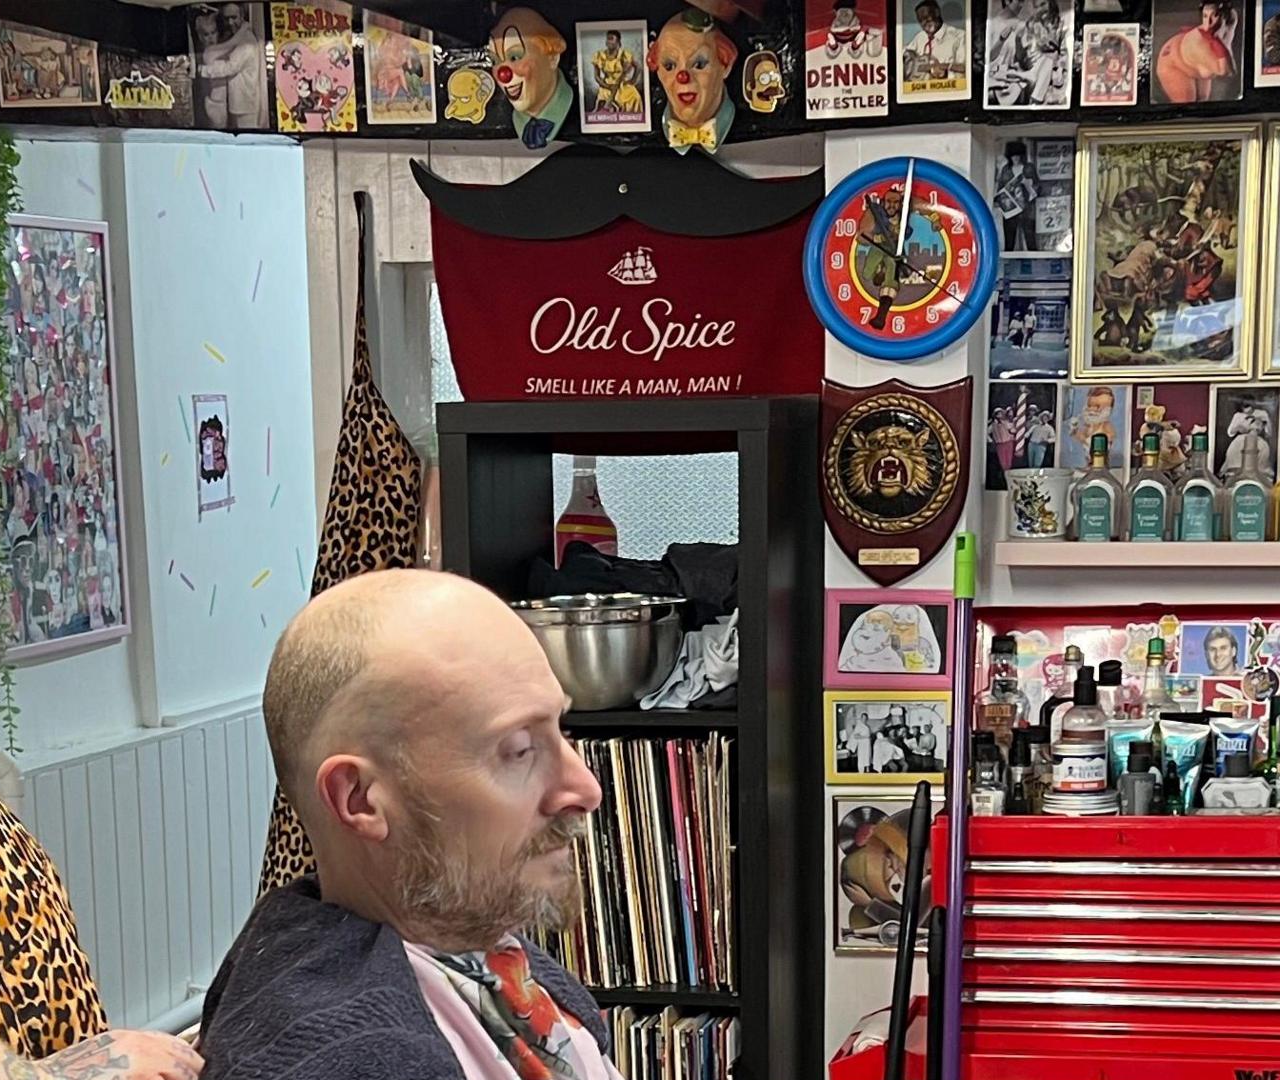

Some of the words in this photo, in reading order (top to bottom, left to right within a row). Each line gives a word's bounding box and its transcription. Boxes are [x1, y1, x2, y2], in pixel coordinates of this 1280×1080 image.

[287, 8, 350, 31] Felix
[807, 62, 887, 89] DENNIS
[112, 81, 171, 105] BATMAN
[841, 87, 853, 95] THE
[911, 82, 927, 92] SON
[930, 80, 957, 90] HOUSE
[807, 95, 888, 111] WRESTLER
[835, 219, 856, 236] 10
[951, 218, 965, 234] 2
[831, 252, 844, 269] 9
[958, 251, 971, 266] 3
[838, 284, 851, 301] 8
[948, 281, 961, 297] 4
[860, 307, 872, 324] 7
[926, 307, 939, 323] 5
[530, 298, 621, 354] Old
[622, 298, 736, 361] Spice
[892, 316, 905, 333] 6
[525, 377, 577, 394] SMELL
[582, 379, 616, 394] LIKE
[619, 380, 632, 394] A
[636, 379, 682, 395] MAN,
[687, 376, 730, 393] MAN
[735, 374, 742, 390] !
